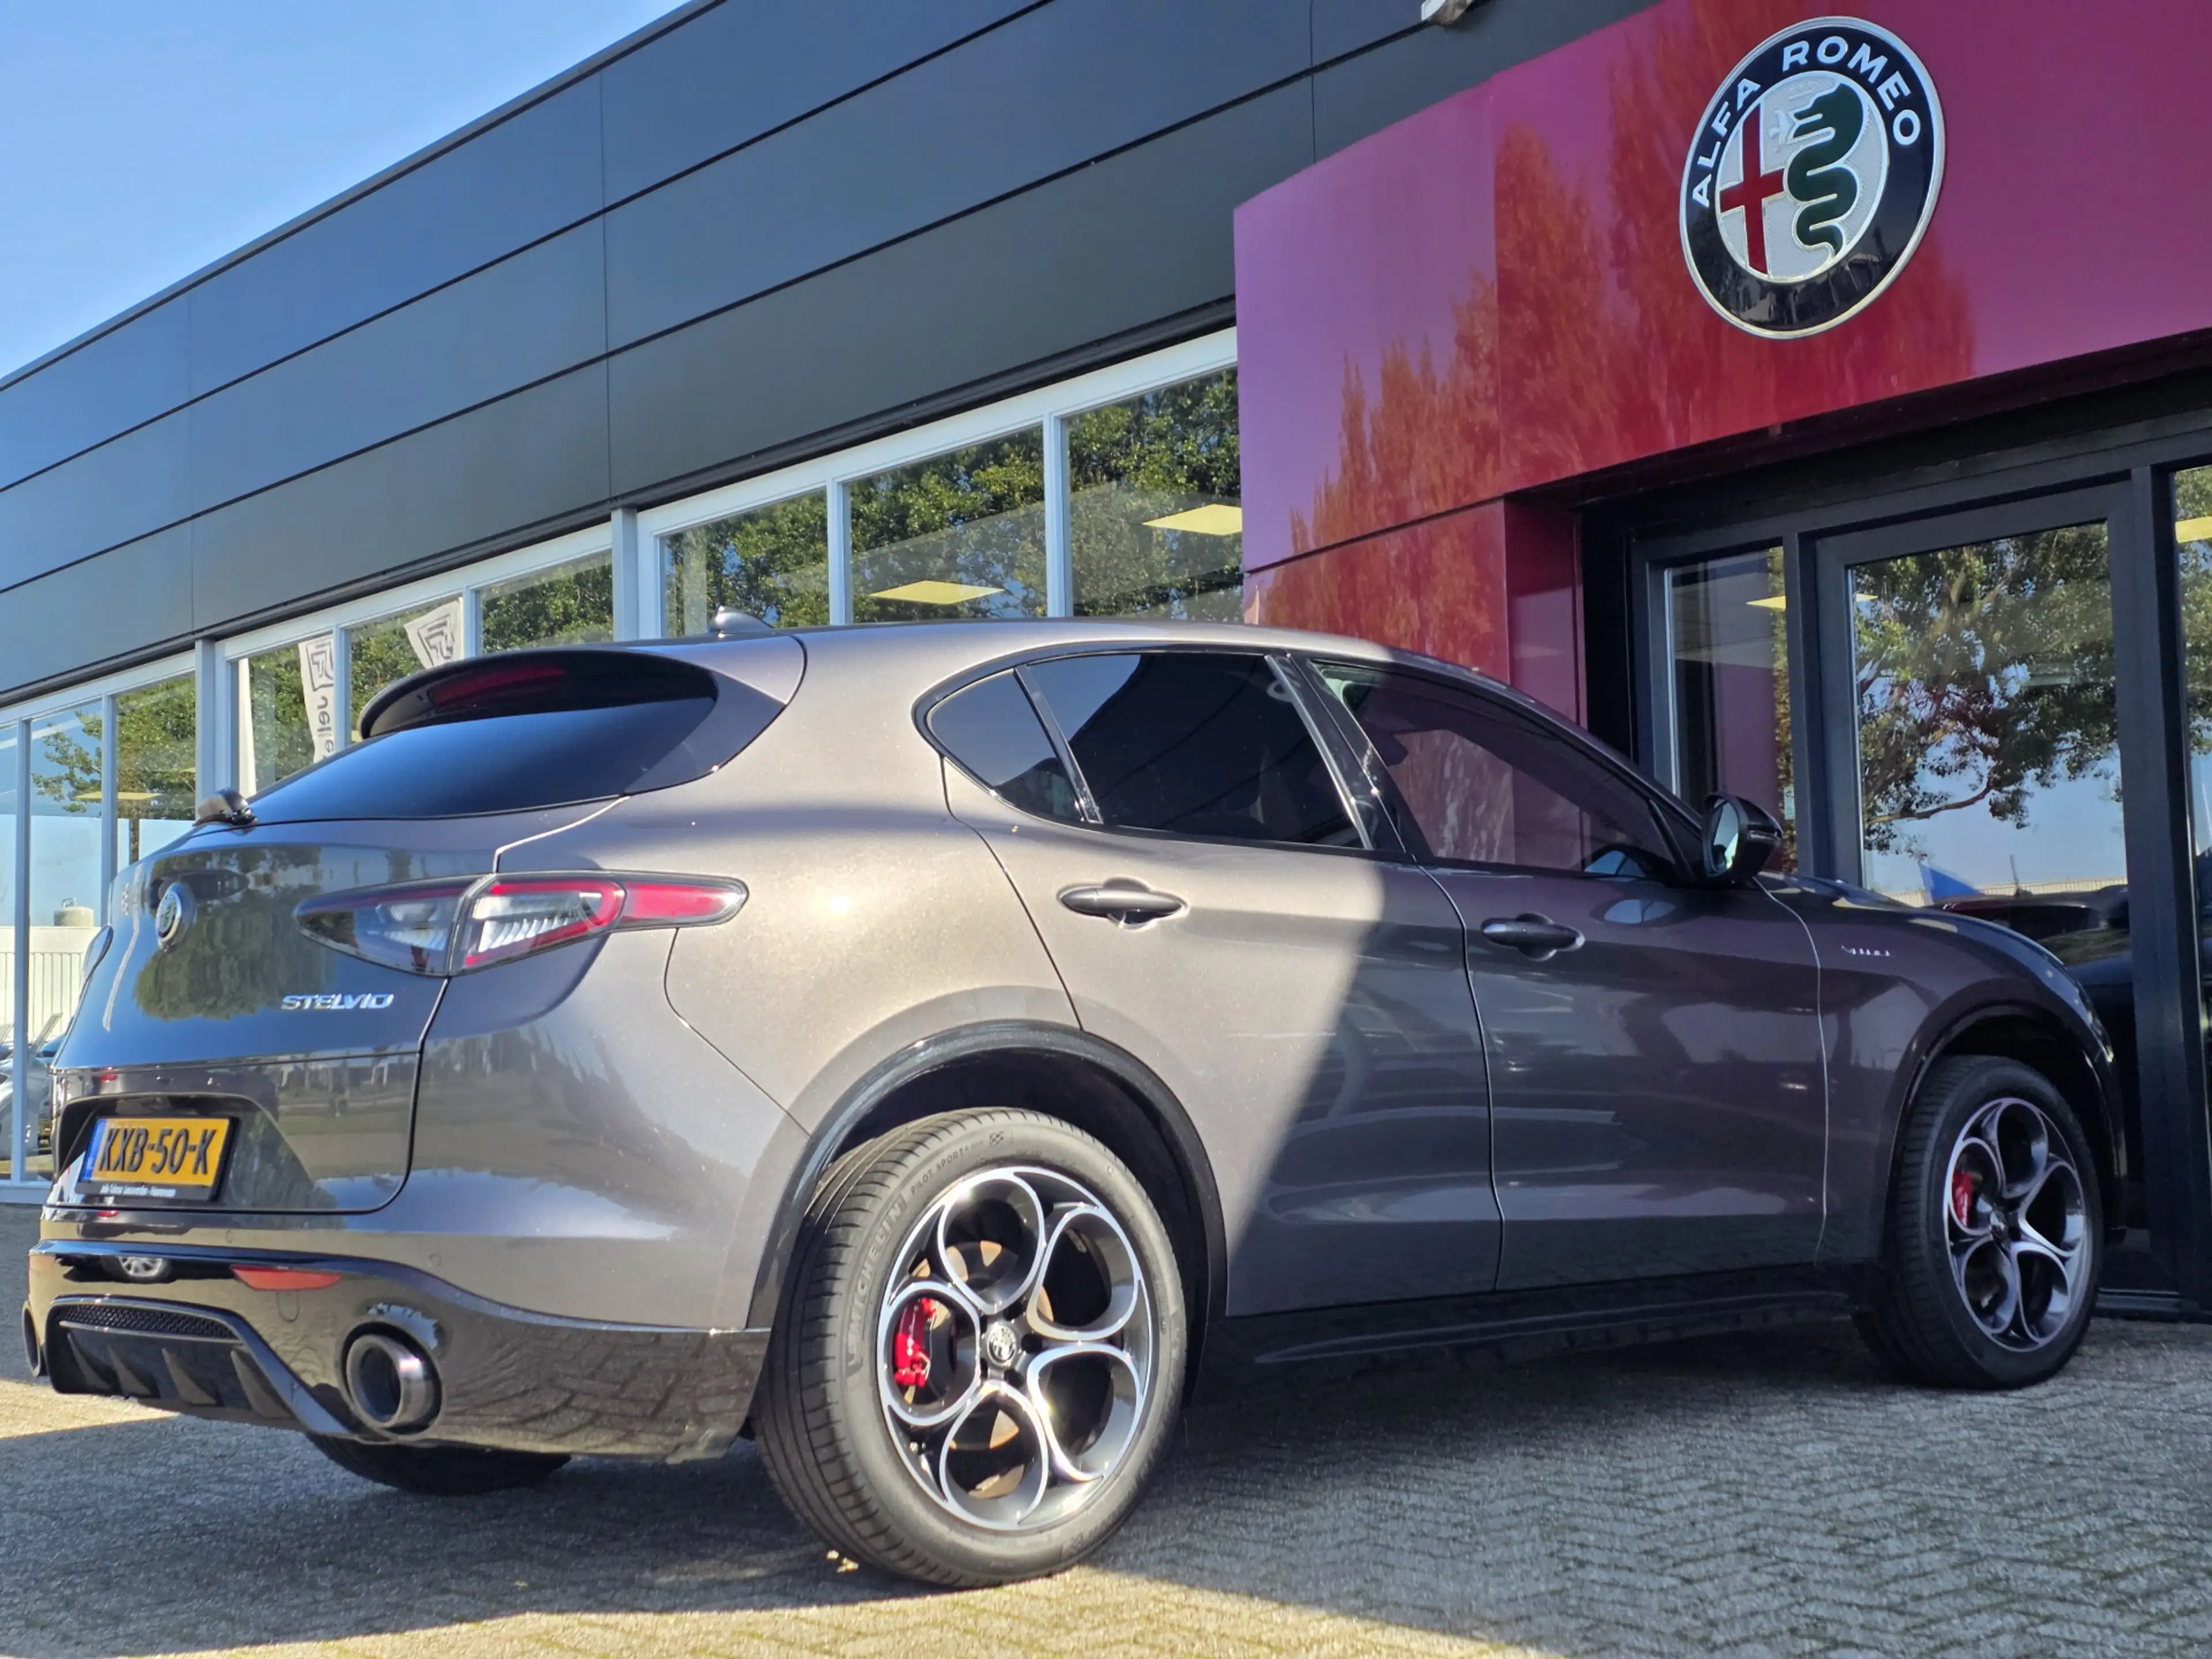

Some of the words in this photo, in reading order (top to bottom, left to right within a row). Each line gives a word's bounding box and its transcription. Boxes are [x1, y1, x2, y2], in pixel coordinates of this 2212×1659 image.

[1692, 78, 1760, 208] ALFA
[1782, 36, 1921, 146] ROMEO
[280, 993, 395, 1010] STELVIO
[98, 1127, 217, 1176] KXB-50-K
[849, 1199, 904, 1336] MICHELIN
[910, 1171, 933, 1196] PILOT
[935, 1147, 964, 1171] SPORT
